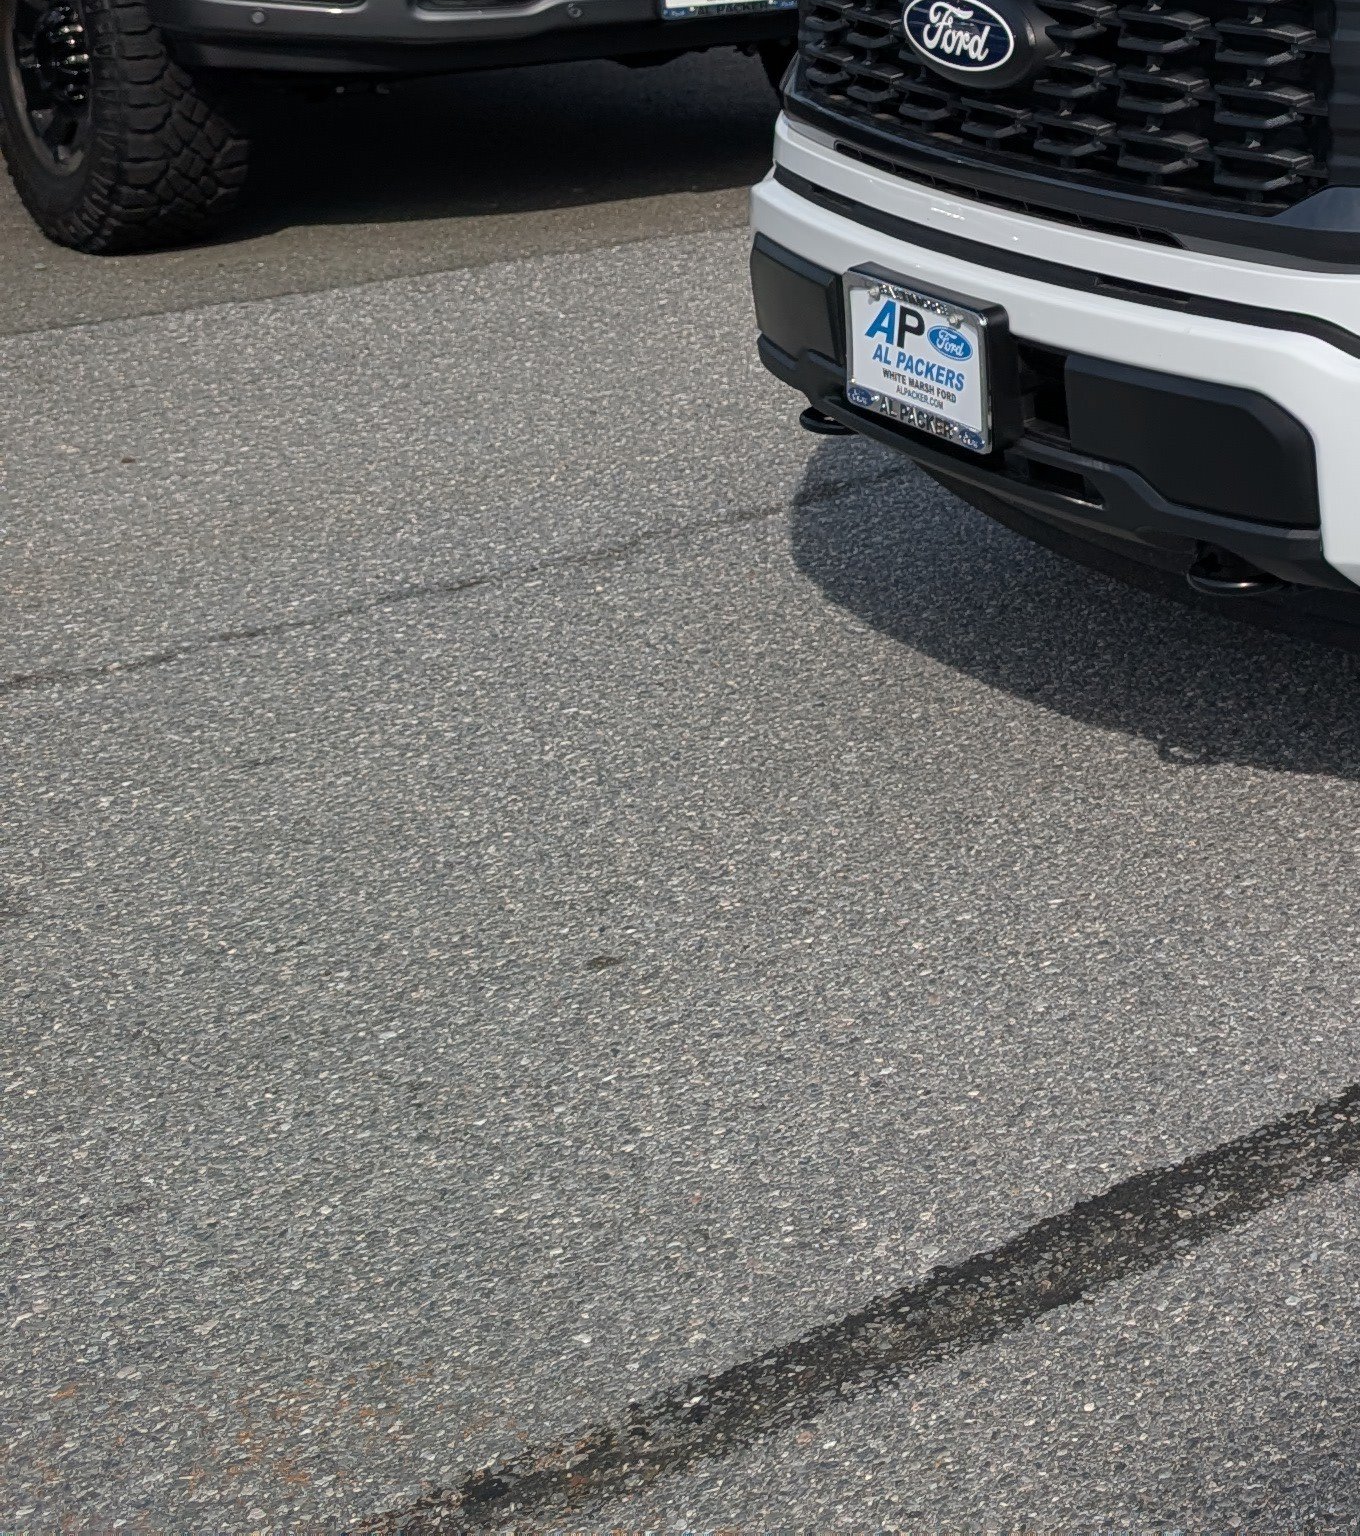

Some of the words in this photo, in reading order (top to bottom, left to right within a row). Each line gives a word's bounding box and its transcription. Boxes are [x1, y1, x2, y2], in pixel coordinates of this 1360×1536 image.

[923, 1, 991, 62] Ford
[864, 299, 926, 349] AP
[936, 330, 965, 357] Ford
[872, 343, 892, 366] AL
[896, 351, 966, 392] PACKERS
[882, 367, 907, 385] WHITE
[908, 377, 935, 396] MARSH
[936, 386, 957, 404] FORD
[879, 396, 898, 417] AL
[896, 384, 944, 410] ALPACKER.COM
